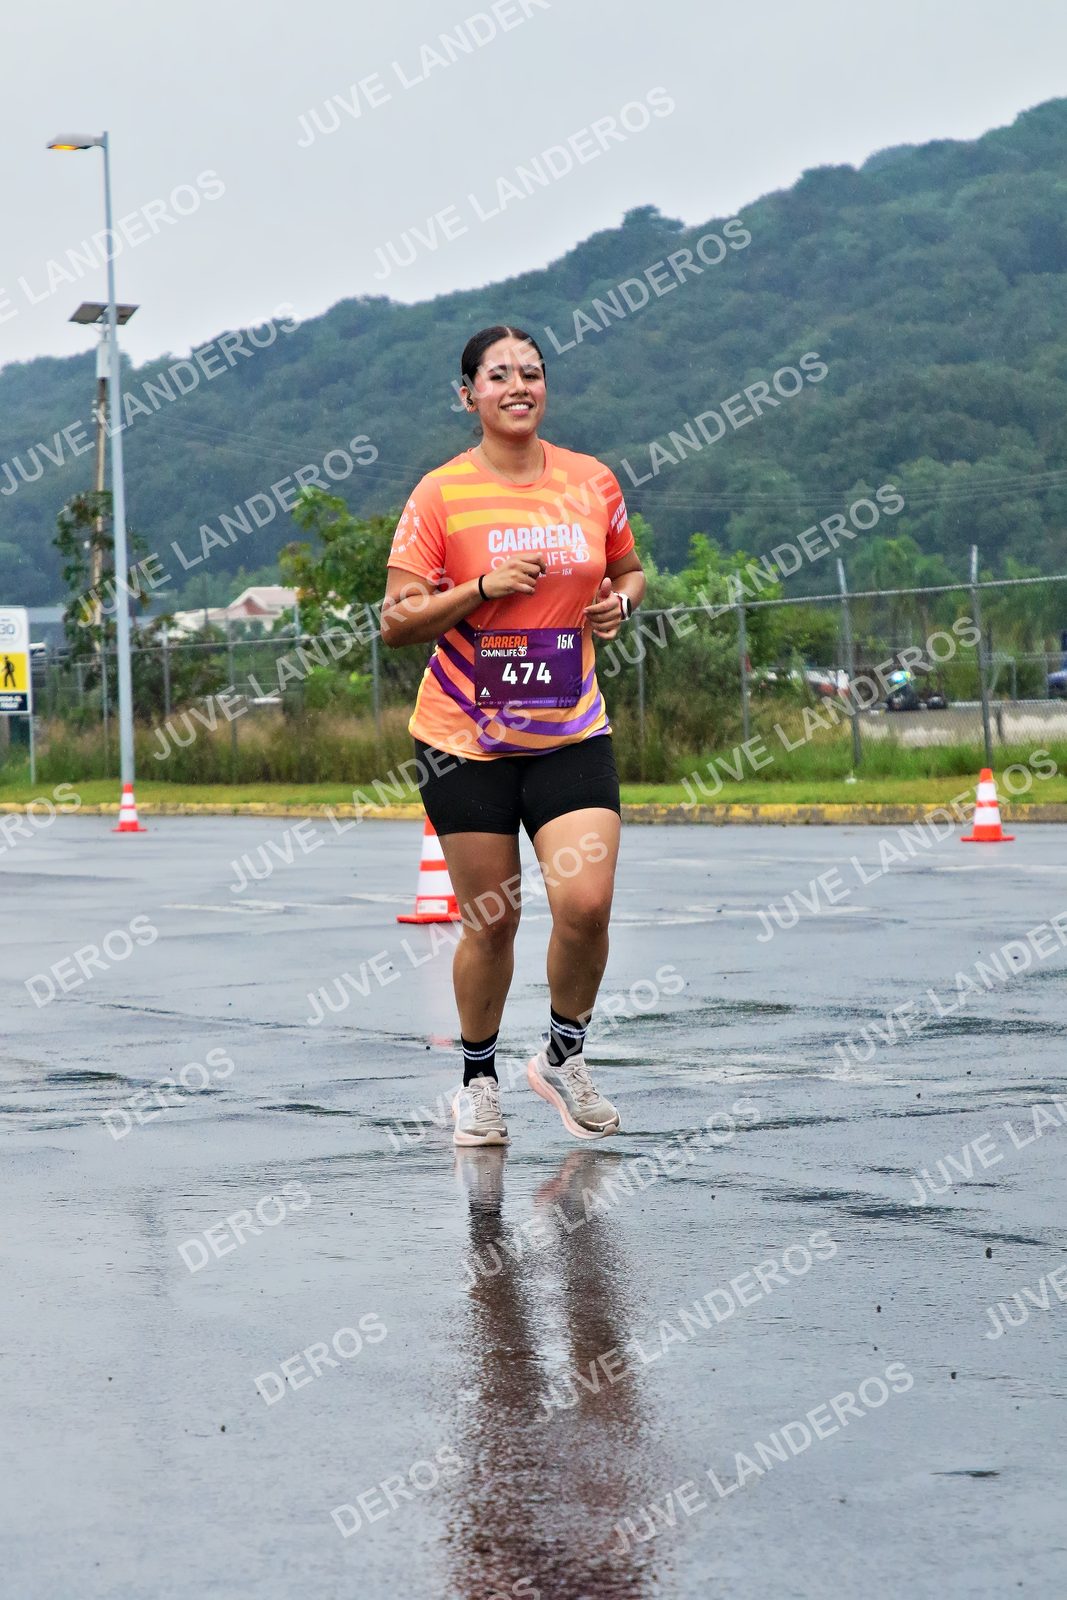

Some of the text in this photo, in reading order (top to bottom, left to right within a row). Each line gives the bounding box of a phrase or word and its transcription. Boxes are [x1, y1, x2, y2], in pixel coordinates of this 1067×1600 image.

[488, 523, 586, 553] CARRERA
[481, 635, 527, 648] CARRERA
[556, 634, 575, 650] 15K
[501, 662, 552, 685] 474
